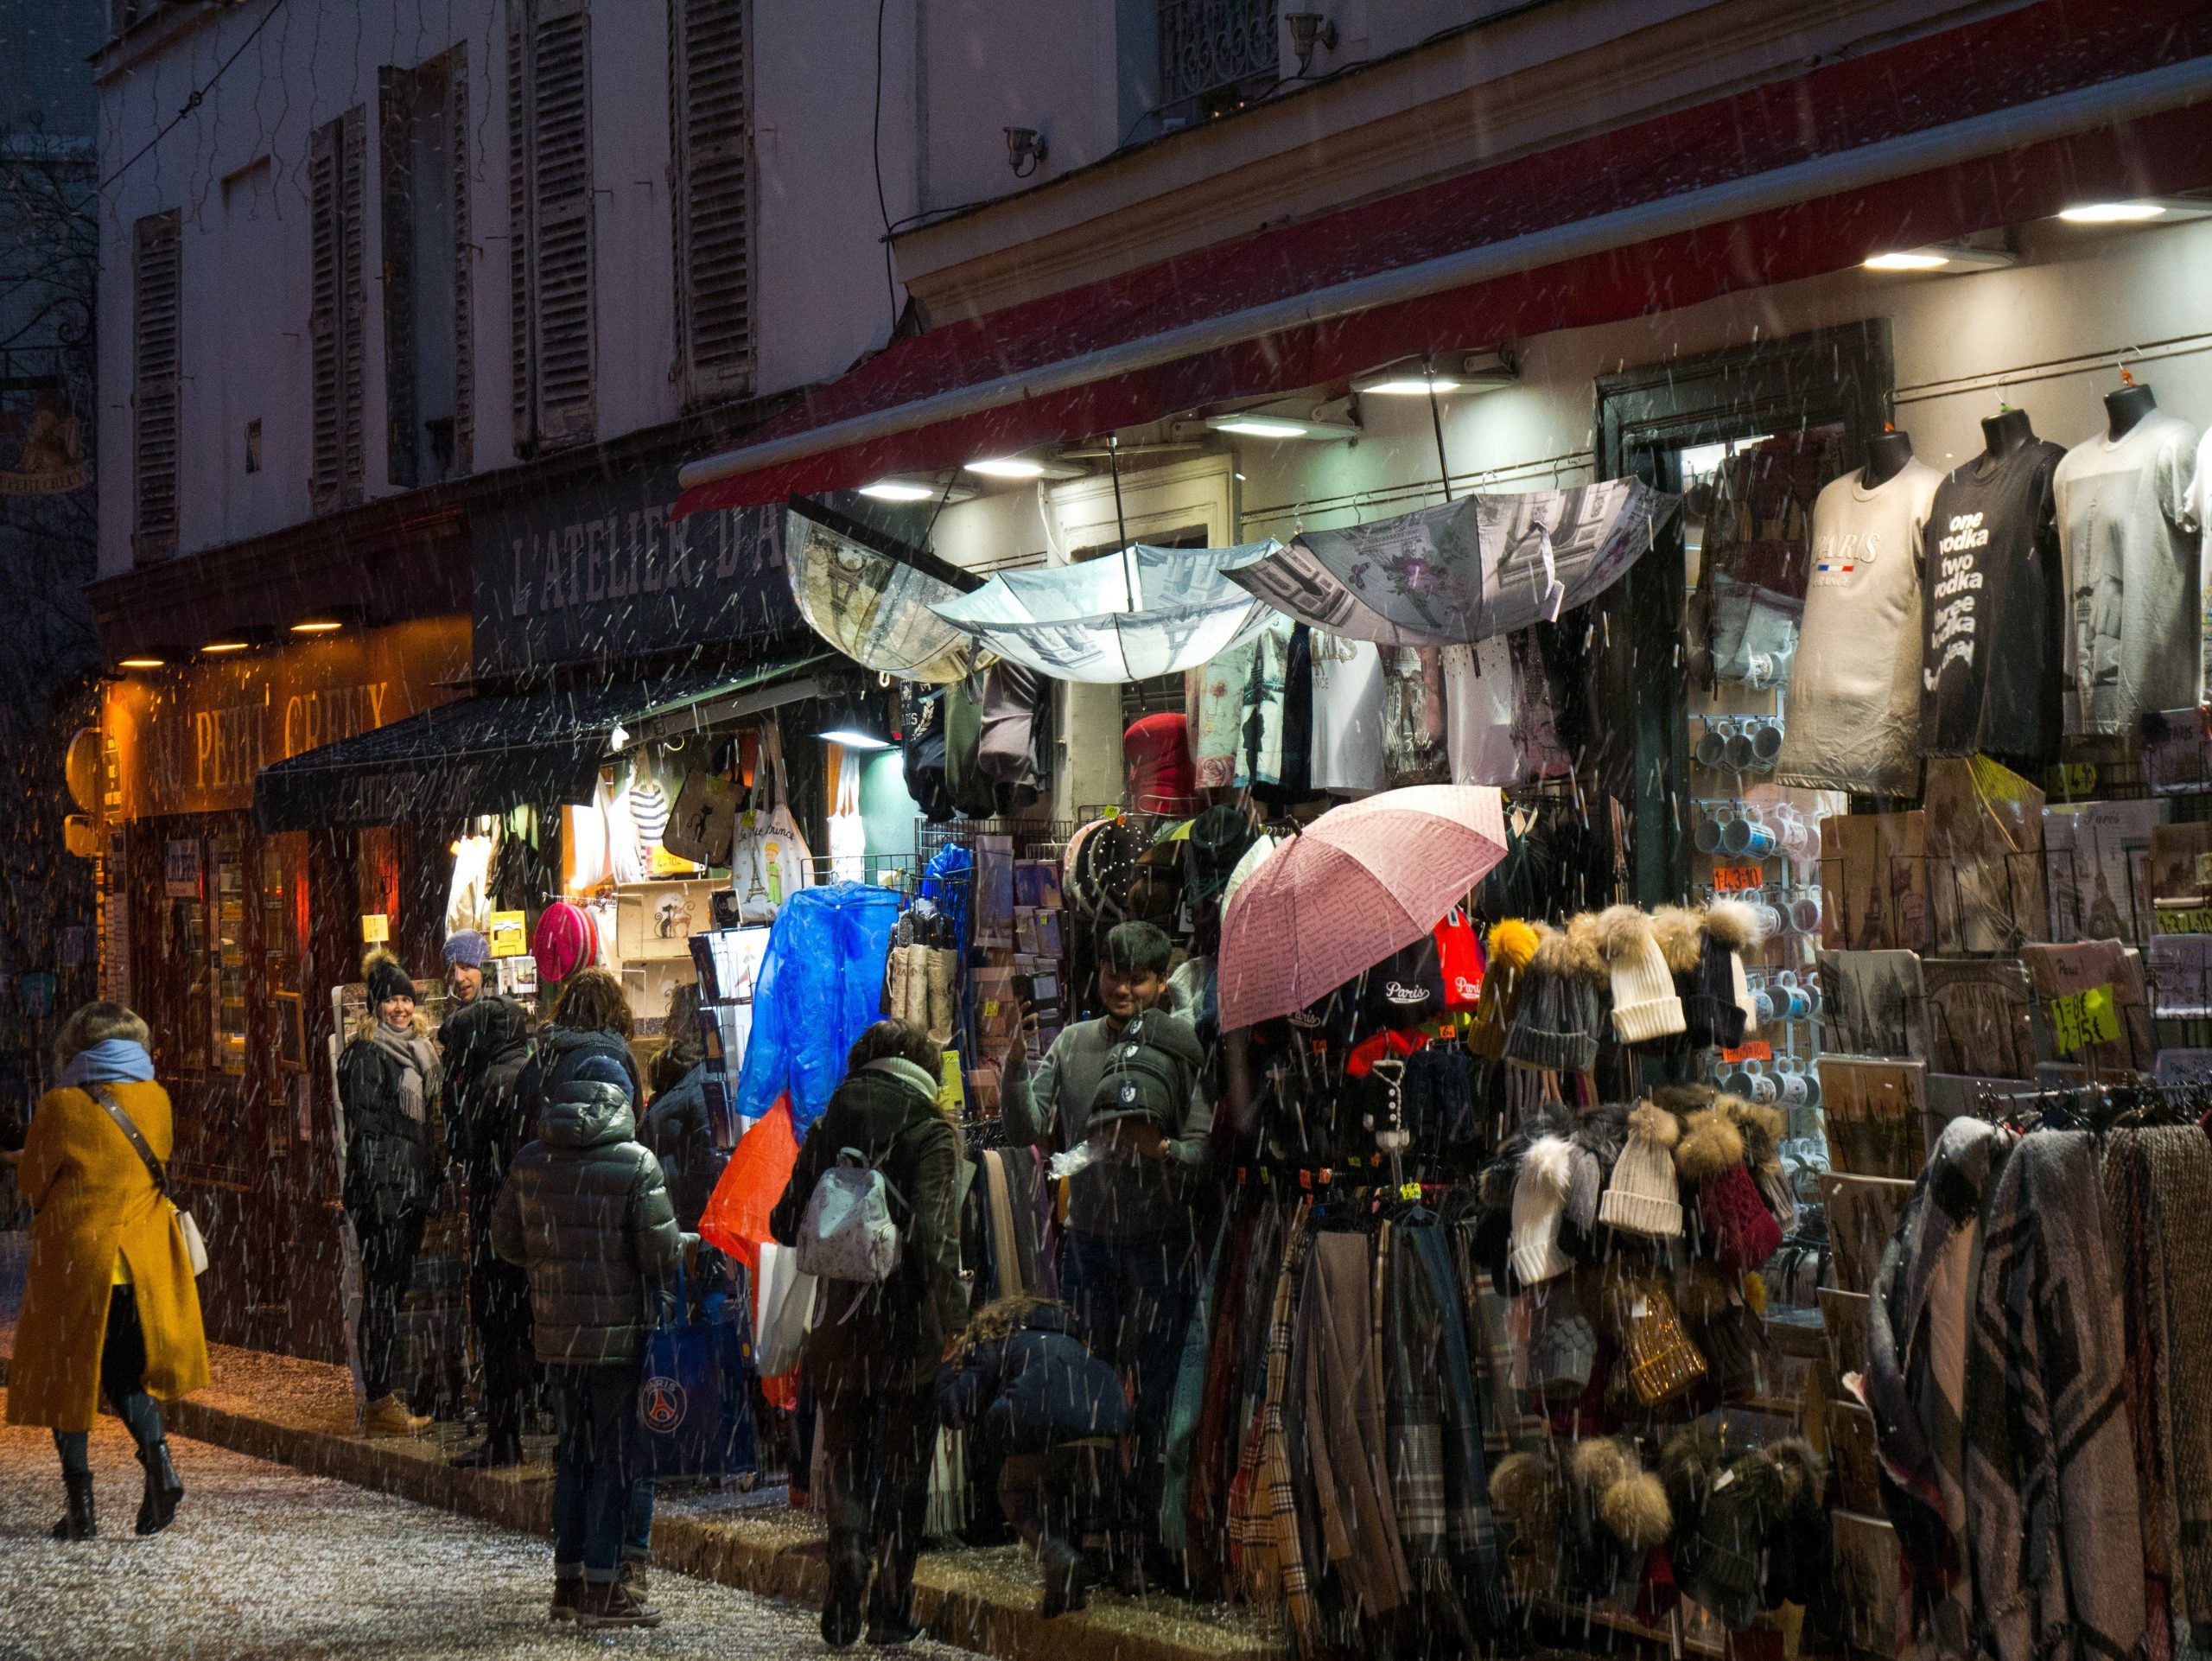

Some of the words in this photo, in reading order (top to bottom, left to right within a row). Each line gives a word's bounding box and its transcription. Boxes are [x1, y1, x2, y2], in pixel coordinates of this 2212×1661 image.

[1949, 512, 1984, 531] one
[1812, 532, 1881, 564] PARIS
[1939, 528, 1989, 555] vodka
[512, 501, 691, 616] L'ATELIER
[716, 503, 783, 579] DA
[1942, 553, 1974, 577] two
[1934, 570, 1984, 599] vodka
[1935, 595, 1976, 631] three
[195, 702, 267, 789] PETIT
[285, 682, 388, 759] CREUX
[1386, 982, 1429, 1000] Paris
[1454, 977, 1479, 993] Pari
[1294, 1009, 1320, 1024] aris
